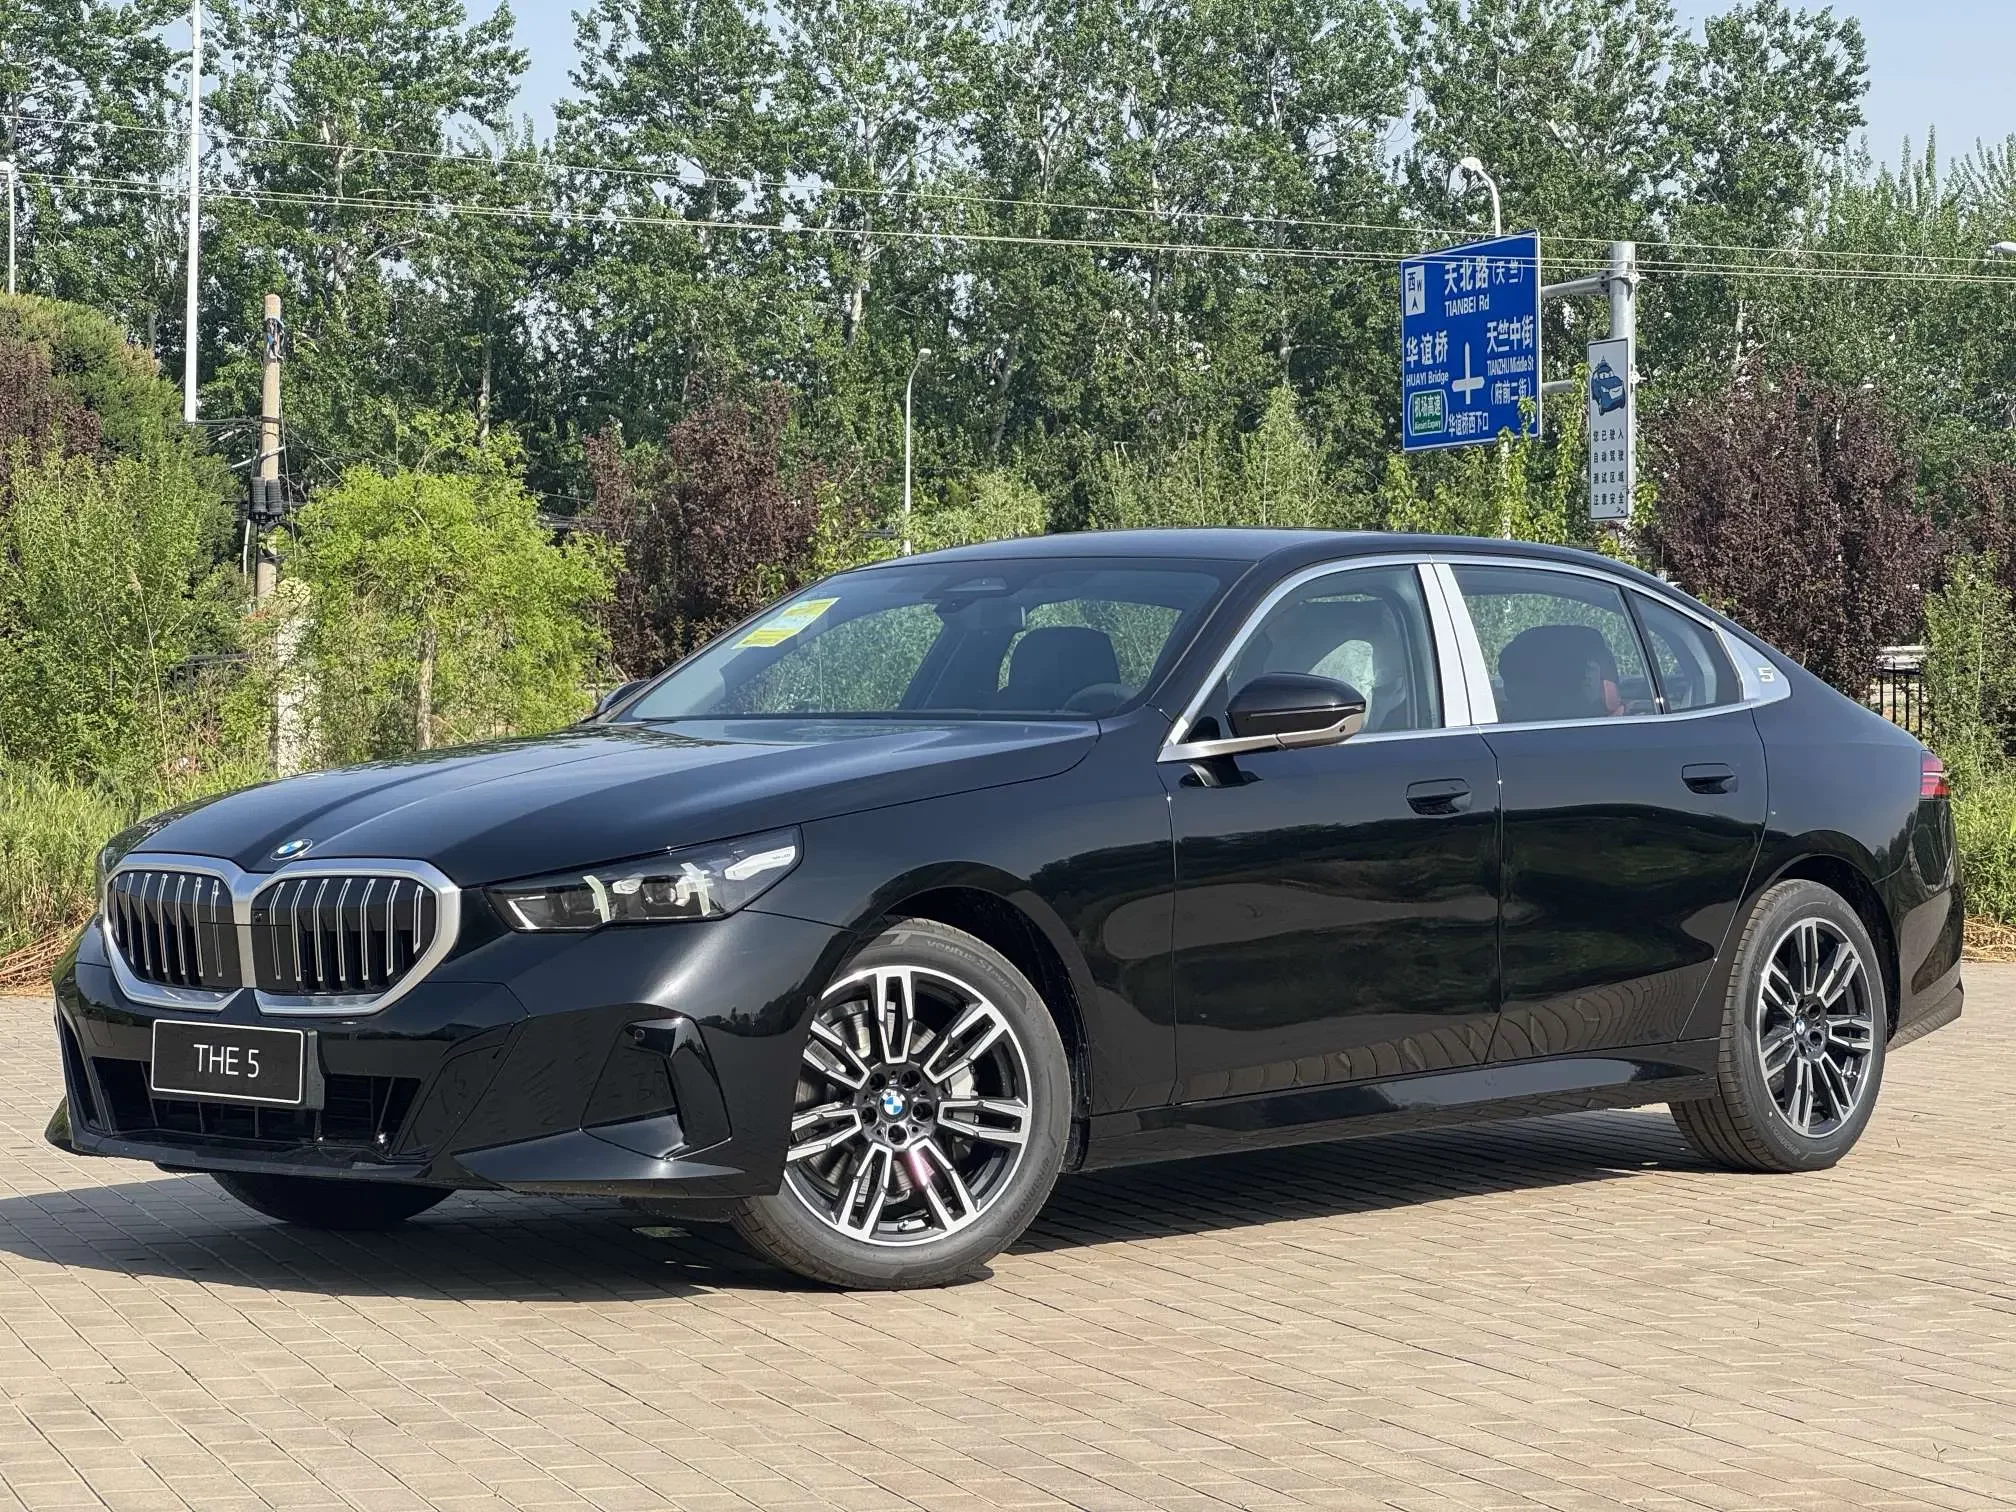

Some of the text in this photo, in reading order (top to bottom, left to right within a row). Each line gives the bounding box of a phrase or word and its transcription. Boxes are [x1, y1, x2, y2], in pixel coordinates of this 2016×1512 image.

[1407, 271, 1417, 291] 西
[1444, 256, 1489, 295] 天北路
[1444, 294, 1490, 317] TIANBEI Rd
[1486, 314, 1534, 354] 天竺中街
[1405, 330, 1448, 368] 华谊桥
[1486, 354, 1535, 376] TIANZHU Middle St
[1406, 369, 1449, 388] HUAYI Bridge
[1414, 394, 1441, 418] 机场高速
[1448, 410, 1489, 437] 华谊桥西下口
[1593, 427, 1624, 443] 您已驶入
[1593, 491, 1624, 506] 注意安全
[193, 1043, 260, 1079] THE 5
